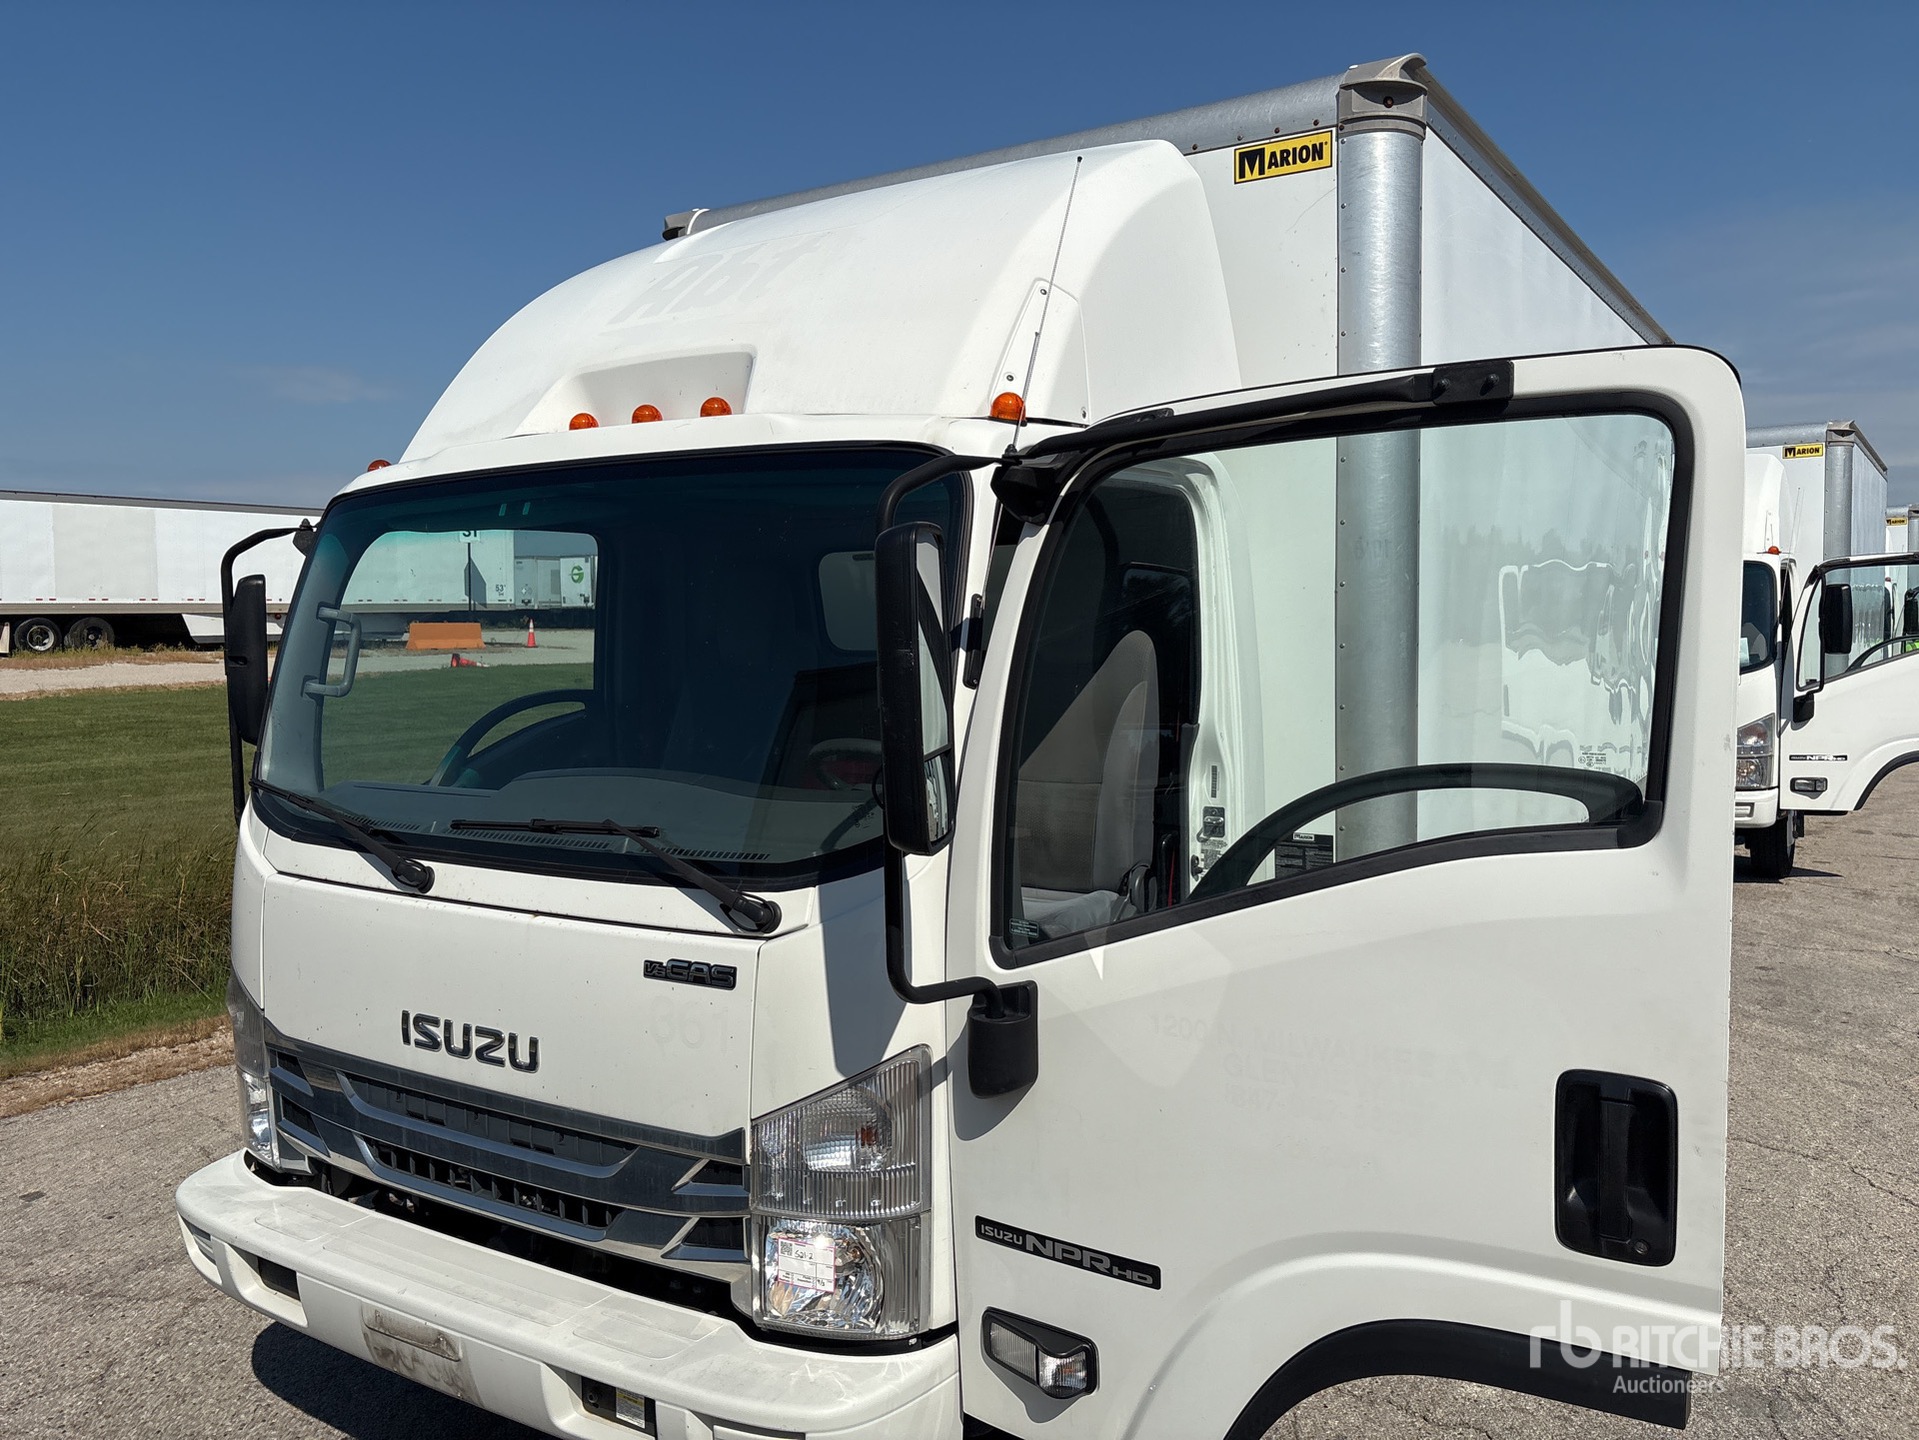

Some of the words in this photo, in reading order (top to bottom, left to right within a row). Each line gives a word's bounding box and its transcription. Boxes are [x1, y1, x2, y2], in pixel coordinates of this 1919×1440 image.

[1238, 142, 1325, 180] MARION
[1784, 447, 1820, 458] MARION
[401, 1009, 541, 1074] ISUZU
[980, 1224, 1023, 1245] ISUZU
